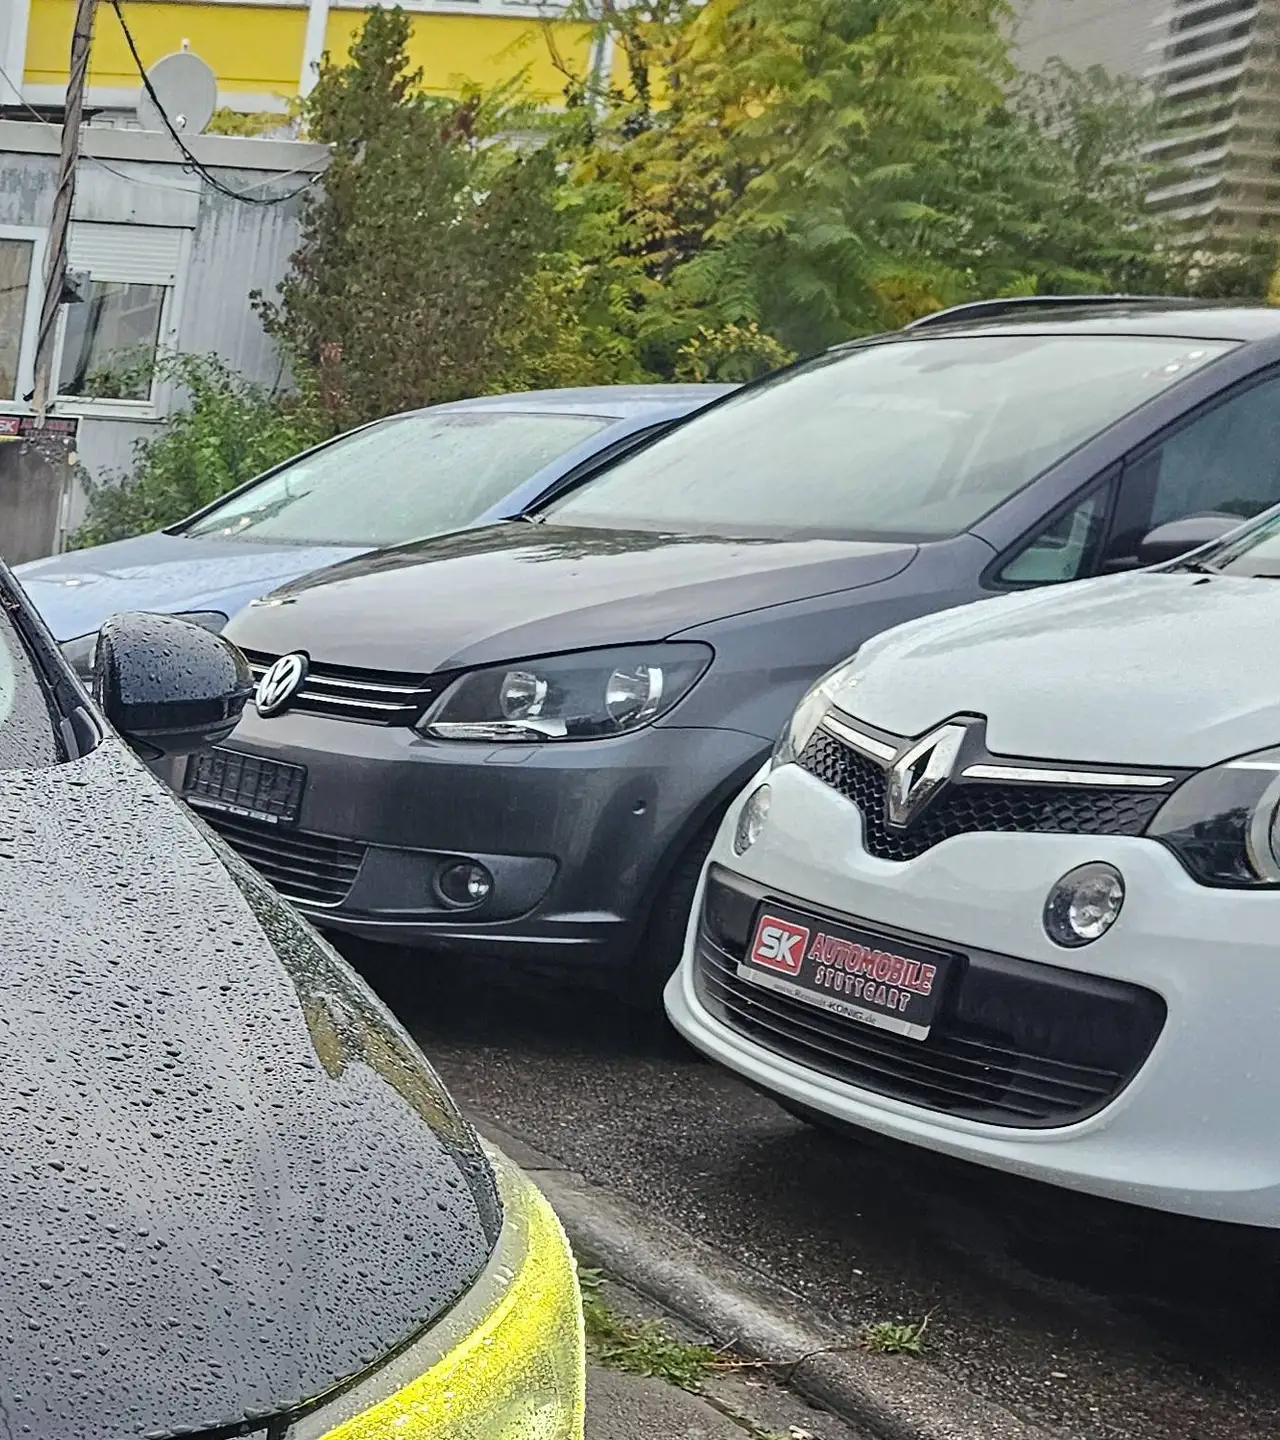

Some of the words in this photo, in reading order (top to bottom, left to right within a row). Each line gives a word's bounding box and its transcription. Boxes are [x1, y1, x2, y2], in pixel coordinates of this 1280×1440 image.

[757, 926, 803, 967] SK
[808, 932, 937, 996] AUTOMOBILE
[814, 965, 911, 1012] STUTTGART
